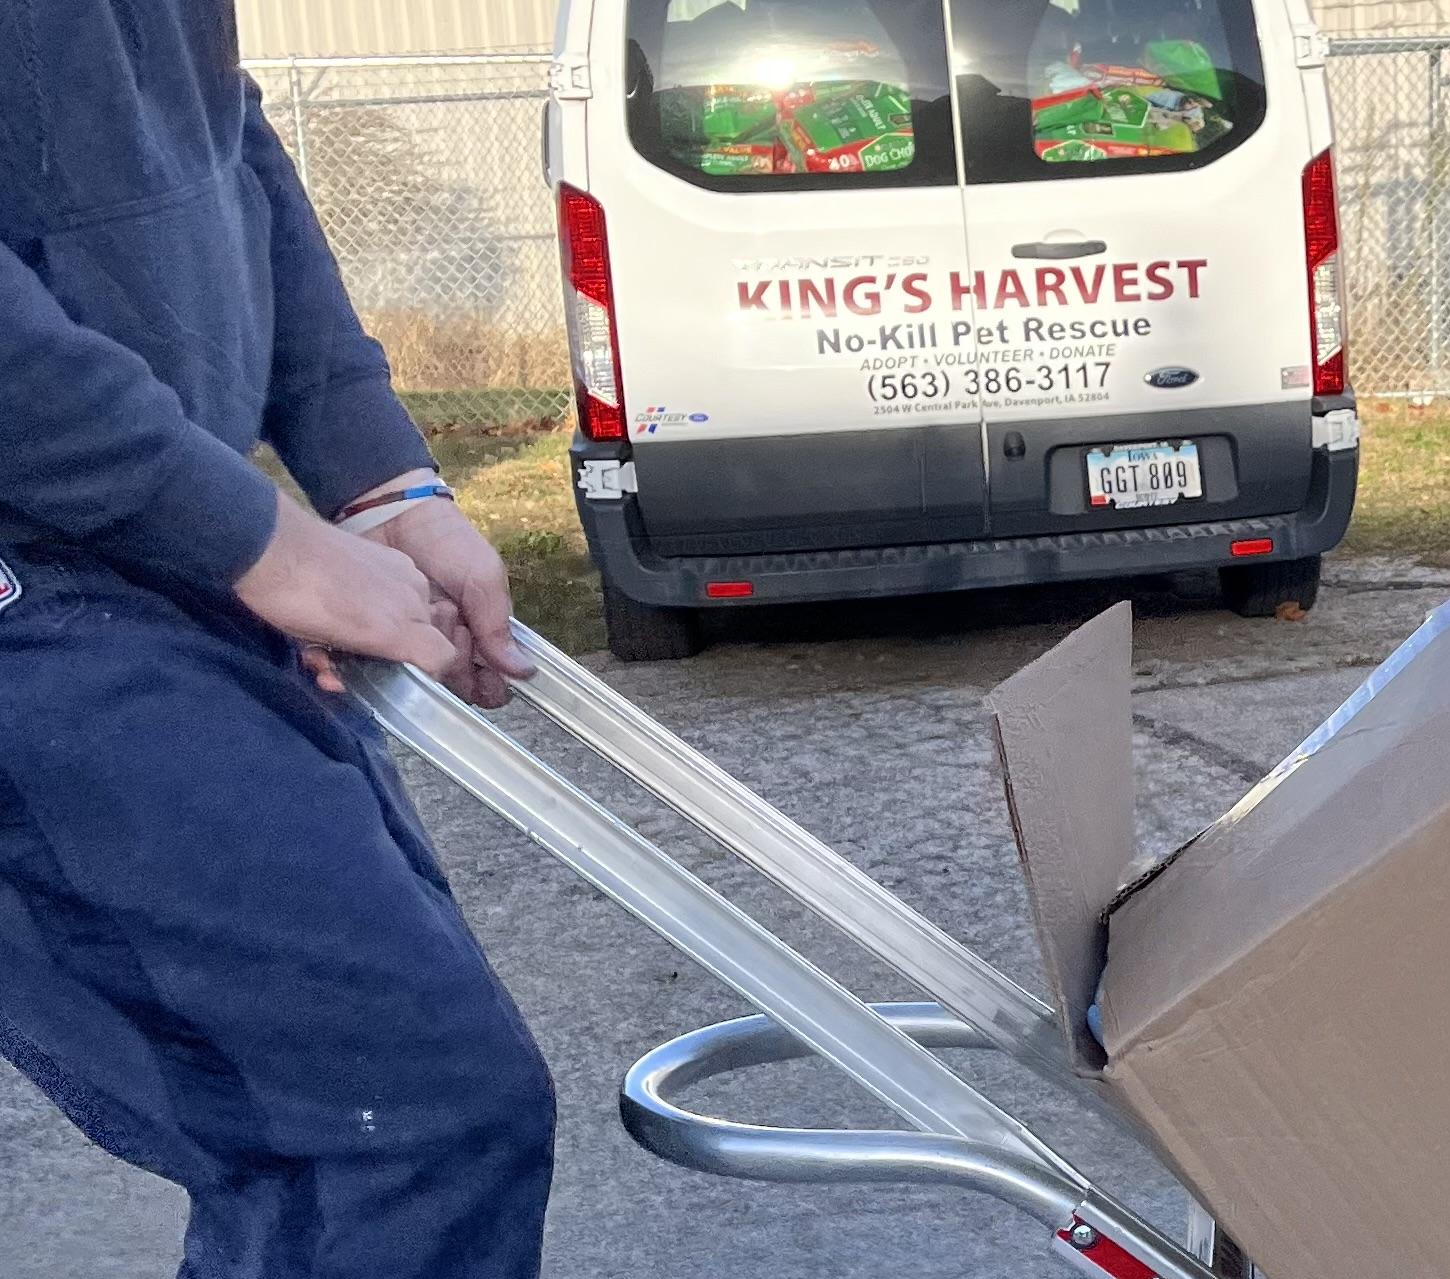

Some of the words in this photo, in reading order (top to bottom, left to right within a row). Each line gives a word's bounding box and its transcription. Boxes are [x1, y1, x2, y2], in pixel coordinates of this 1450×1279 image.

[864, 152, 889, 168] DOG
[736, 272, 933, 320] KING'S
[950, 258, 1208, 311] HARVEST
[816, 322, 938, 355] No-Kill
[951, 319, 1010, 346] Pet
[1023, 316, 1152, 343] Rescue
[859, 355, 918, 371] ADOPT
[933, 348, 1035, 367] VOLUNTEER
[1049, 343, 1117, 361] DONATE
[867, 370, 951, 402] (563)
[963, 362, 1111, 396] 386-3117
[873, 404, 900, 416] 2504
[901, 403, 913, 414] W
[914, 400, 952, 413] Central
[954, 398, 978, 410] Park
[1077, 391, 1111, 403] 52804
[1100, 464, 1139, 495] GGT
[1149, 460, 1187, 490] 809
